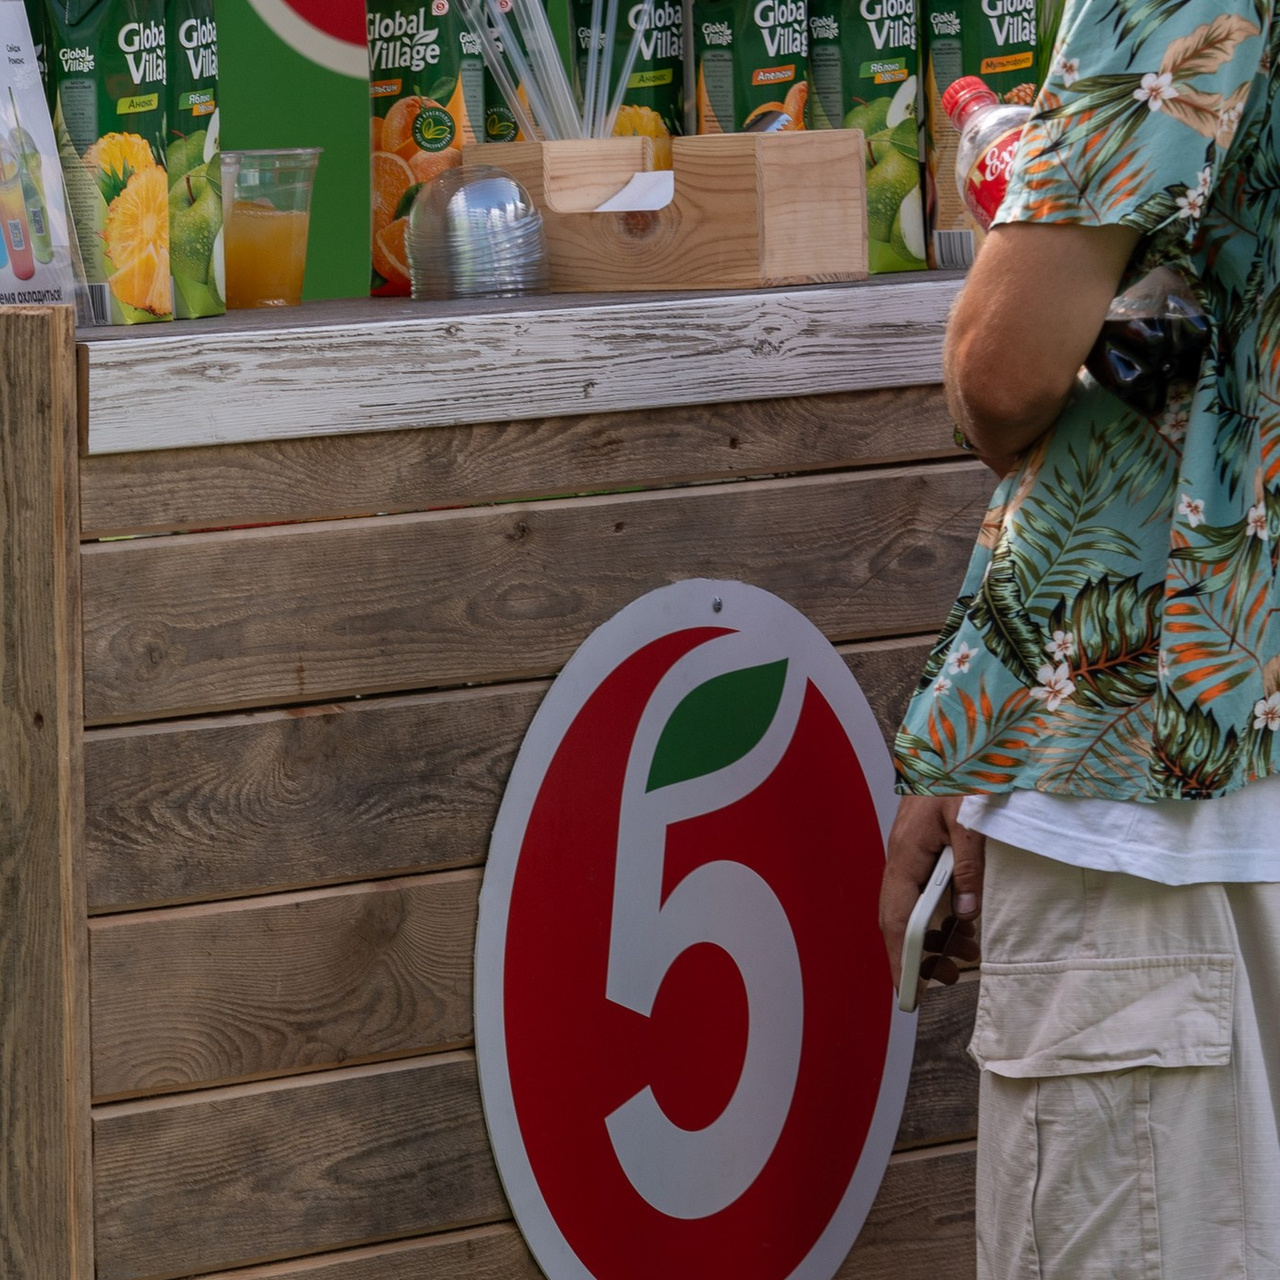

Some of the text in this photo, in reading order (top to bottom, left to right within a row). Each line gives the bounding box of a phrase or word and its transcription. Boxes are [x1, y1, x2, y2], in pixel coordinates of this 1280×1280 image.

[118, 19, 166, 53] Globa
[59, 47, 94, 61] Global
[368, 39, 440, 72] Village
[62, 59, 95, 73] Village
[757, 70, 793, 81] Апельсин
